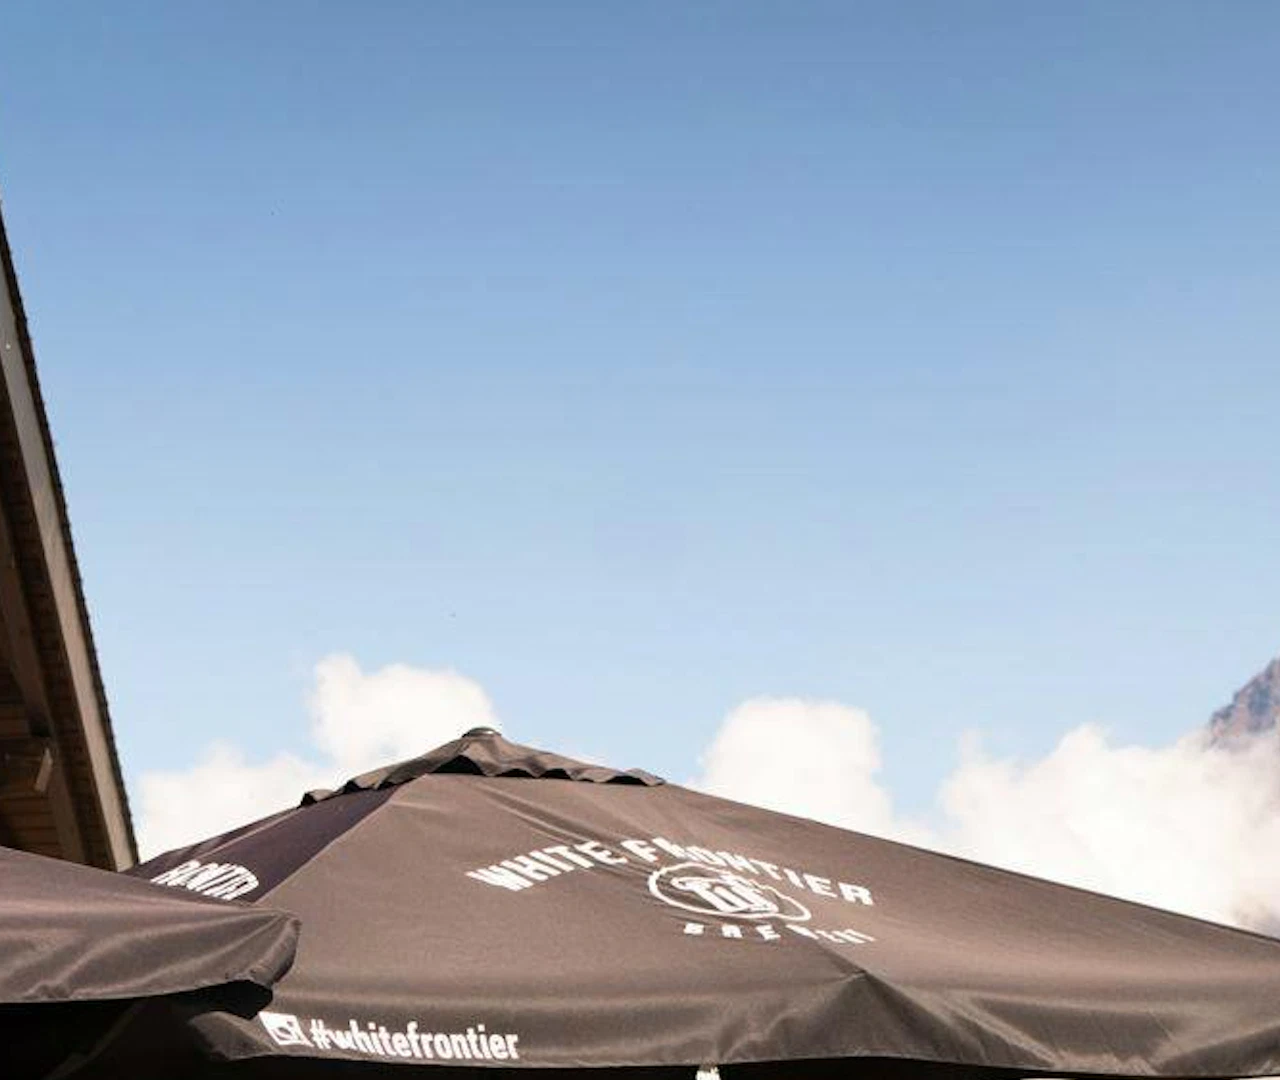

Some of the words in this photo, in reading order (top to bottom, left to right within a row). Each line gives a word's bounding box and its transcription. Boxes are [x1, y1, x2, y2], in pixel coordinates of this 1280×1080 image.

[464, 840, 629, 892] WHITE
[620, 836, 874, 906] FRONTIER
[309, 1017, 520, 1061] #whitefrontier
